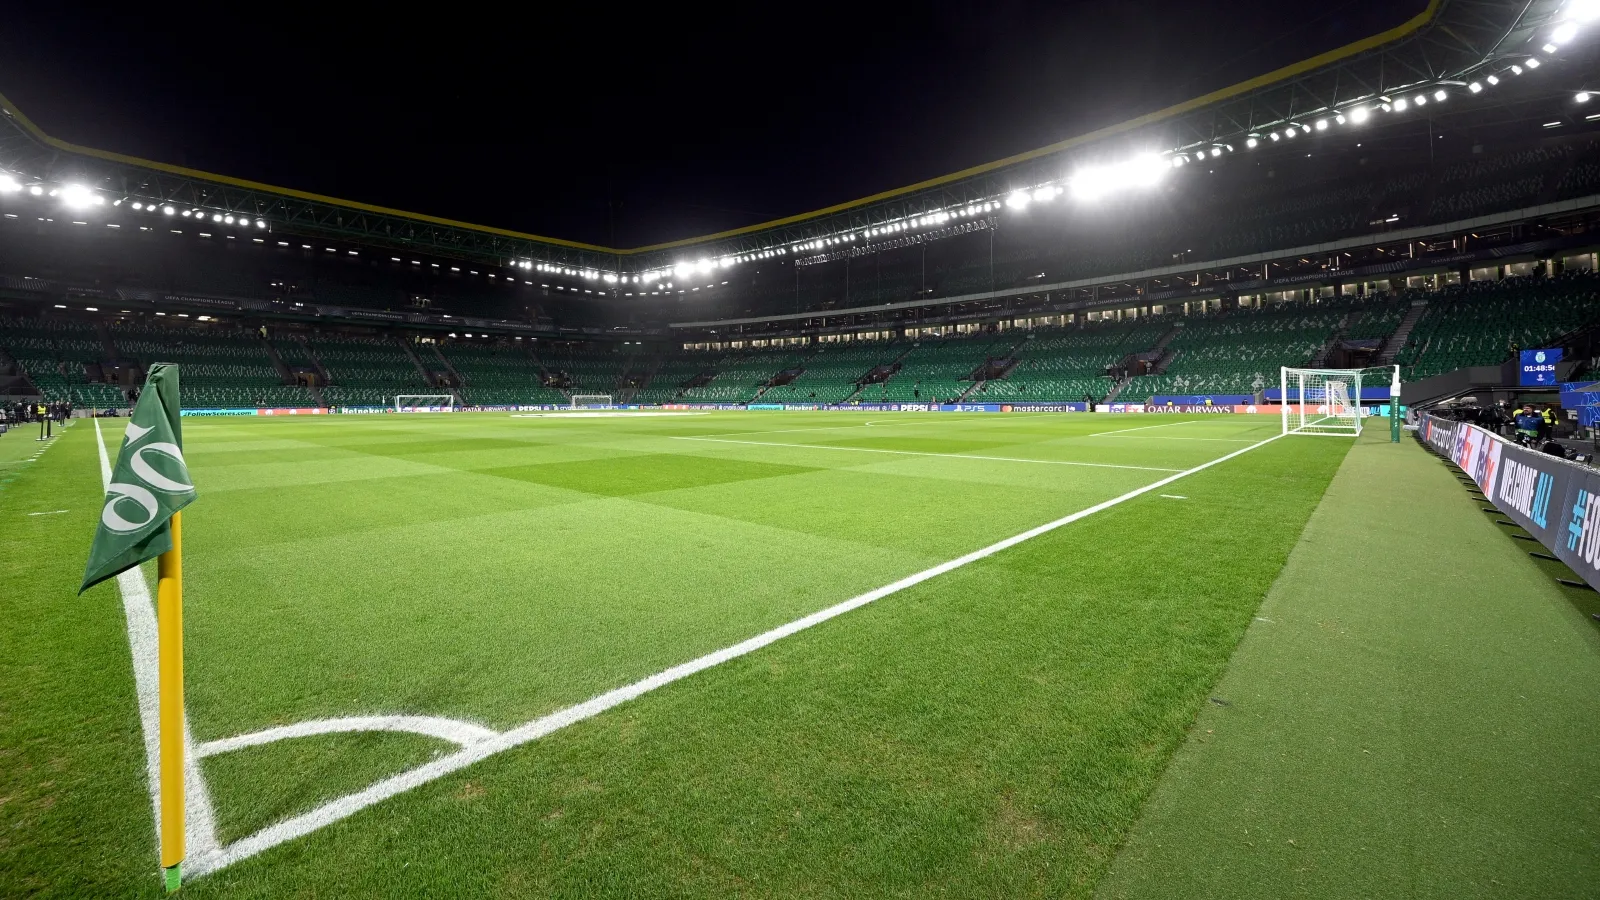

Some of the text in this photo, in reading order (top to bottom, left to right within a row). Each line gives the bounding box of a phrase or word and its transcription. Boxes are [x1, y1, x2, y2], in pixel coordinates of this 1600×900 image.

[1290, 273, 1328, 282] CHAMPIONS
[1148, 405, 1230, 414] QATAR AIRWAYS
[1500, 458, 1554, 530] WELCOME ALL
